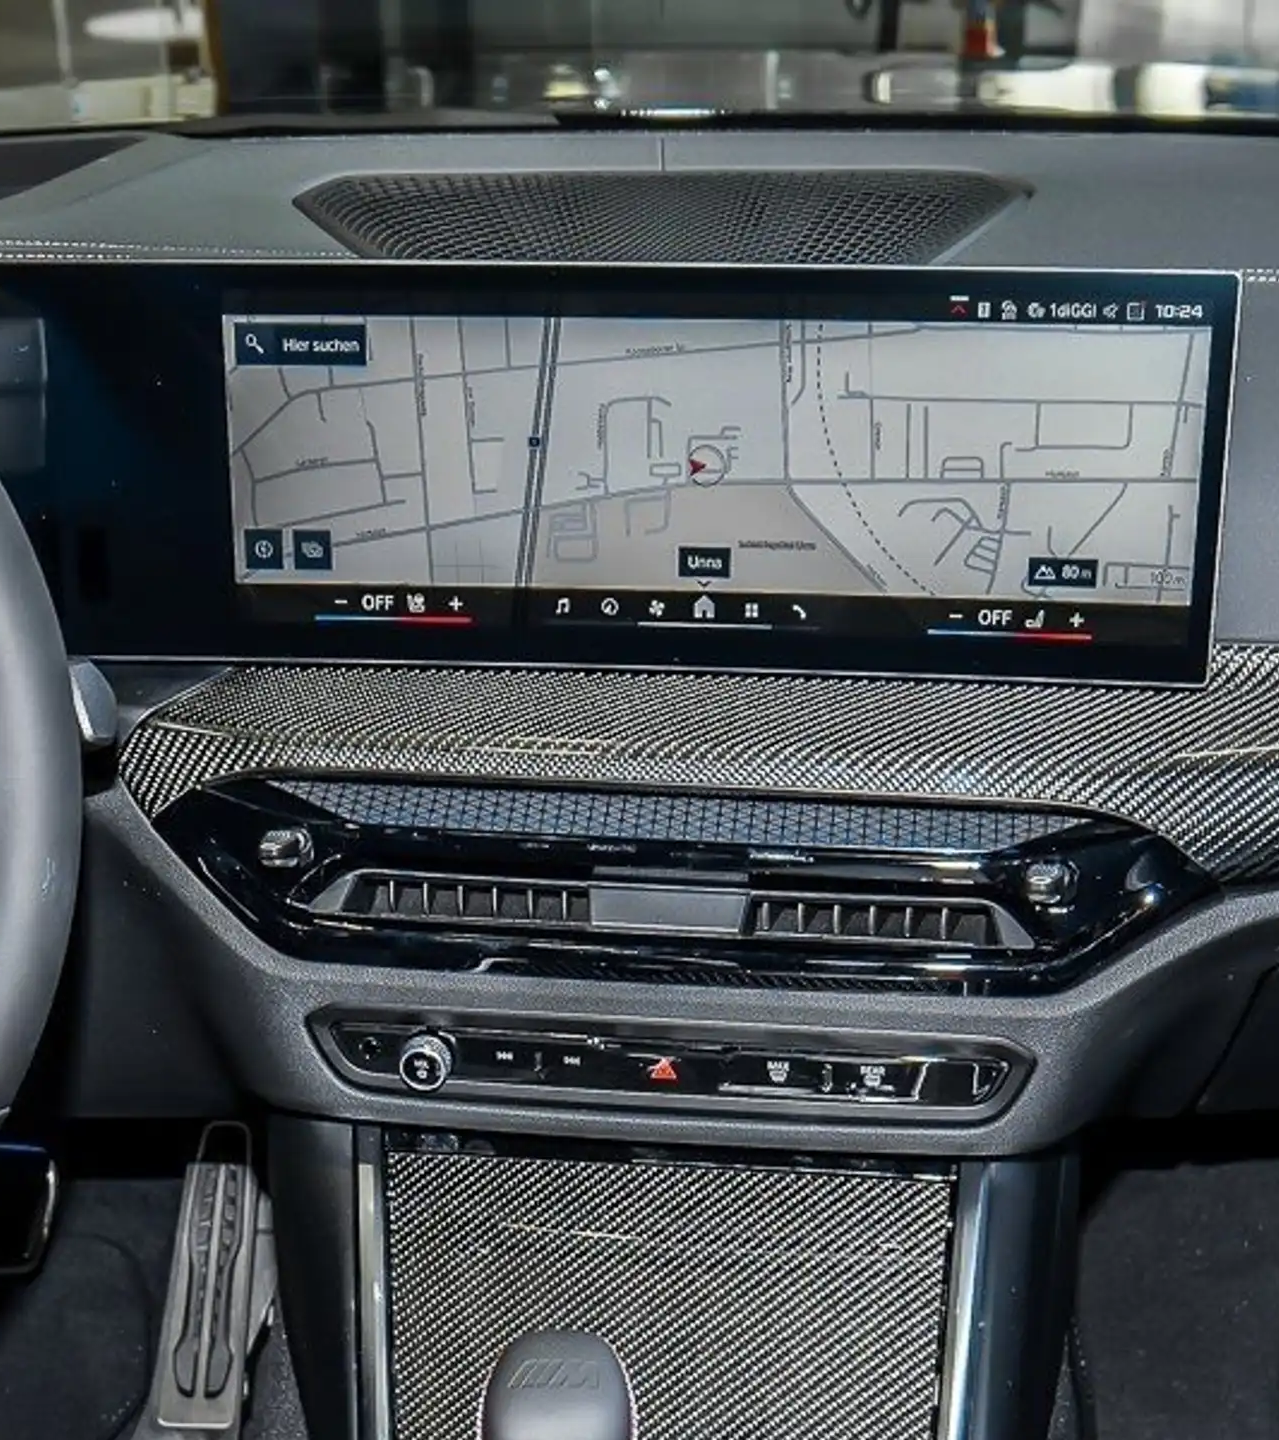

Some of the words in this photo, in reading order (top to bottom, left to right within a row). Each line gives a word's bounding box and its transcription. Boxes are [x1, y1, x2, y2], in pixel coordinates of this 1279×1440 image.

[1155, 304, 1203, 318] 10:24
[282, 338, 309, 351] Hier
[313, 337, 360, 351] suchen
[687, 555, 723, 570] Unna
[1061, 566, 1079, 578] 80
[361, 594, 394, 611] OFF
[978, 609, 1012, 626] OFF
[860, 1065, 886, 1075] REAR
